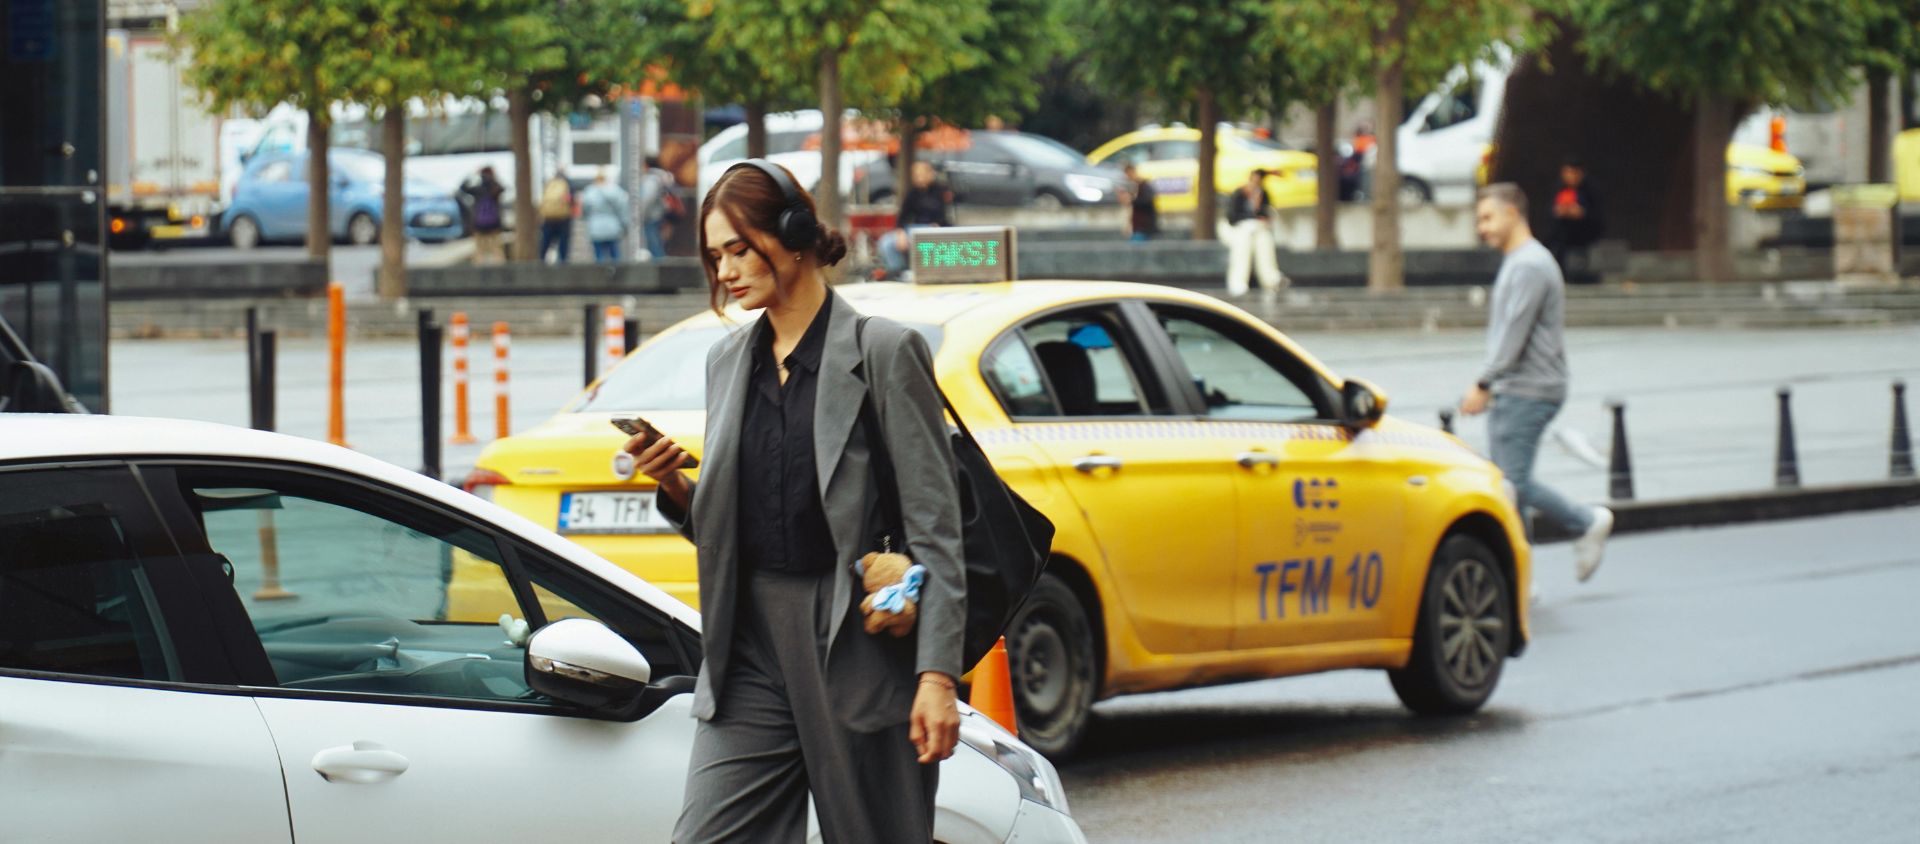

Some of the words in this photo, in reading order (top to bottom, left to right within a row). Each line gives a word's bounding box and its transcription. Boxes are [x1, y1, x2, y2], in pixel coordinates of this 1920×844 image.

[917, 240, 999, 267] TAKSI
[573, 498, 595, 523] 34
[613, 497, 652, 523] TFM
[1255, 555, 1333, 620] TFM
[1346, 551, 1383, 609] 10
